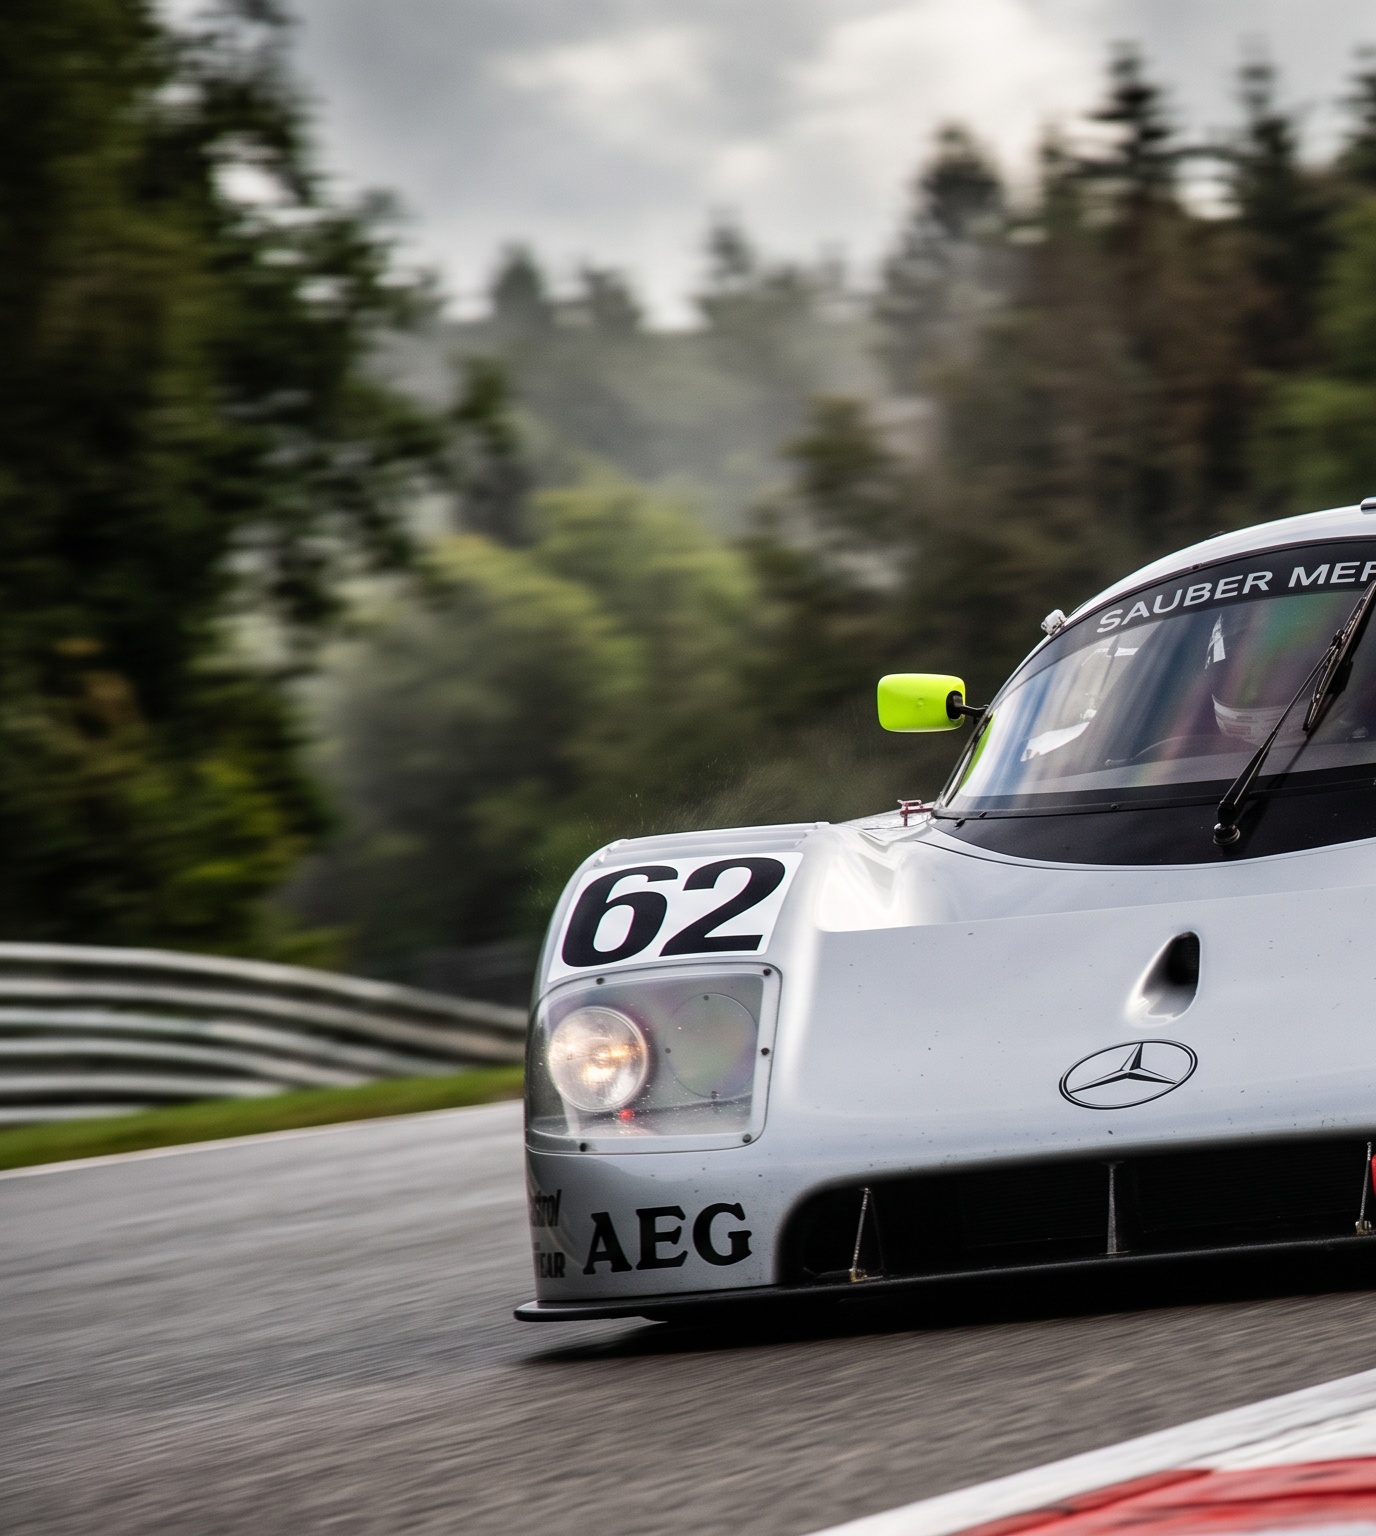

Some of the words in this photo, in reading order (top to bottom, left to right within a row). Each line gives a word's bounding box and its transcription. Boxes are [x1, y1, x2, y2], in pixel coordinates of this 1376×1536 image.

[1096, 571, 1273, 634] SAUBER
[561, 856, 786, 968] 62
[583, 1202, 753, 1275] AEG
